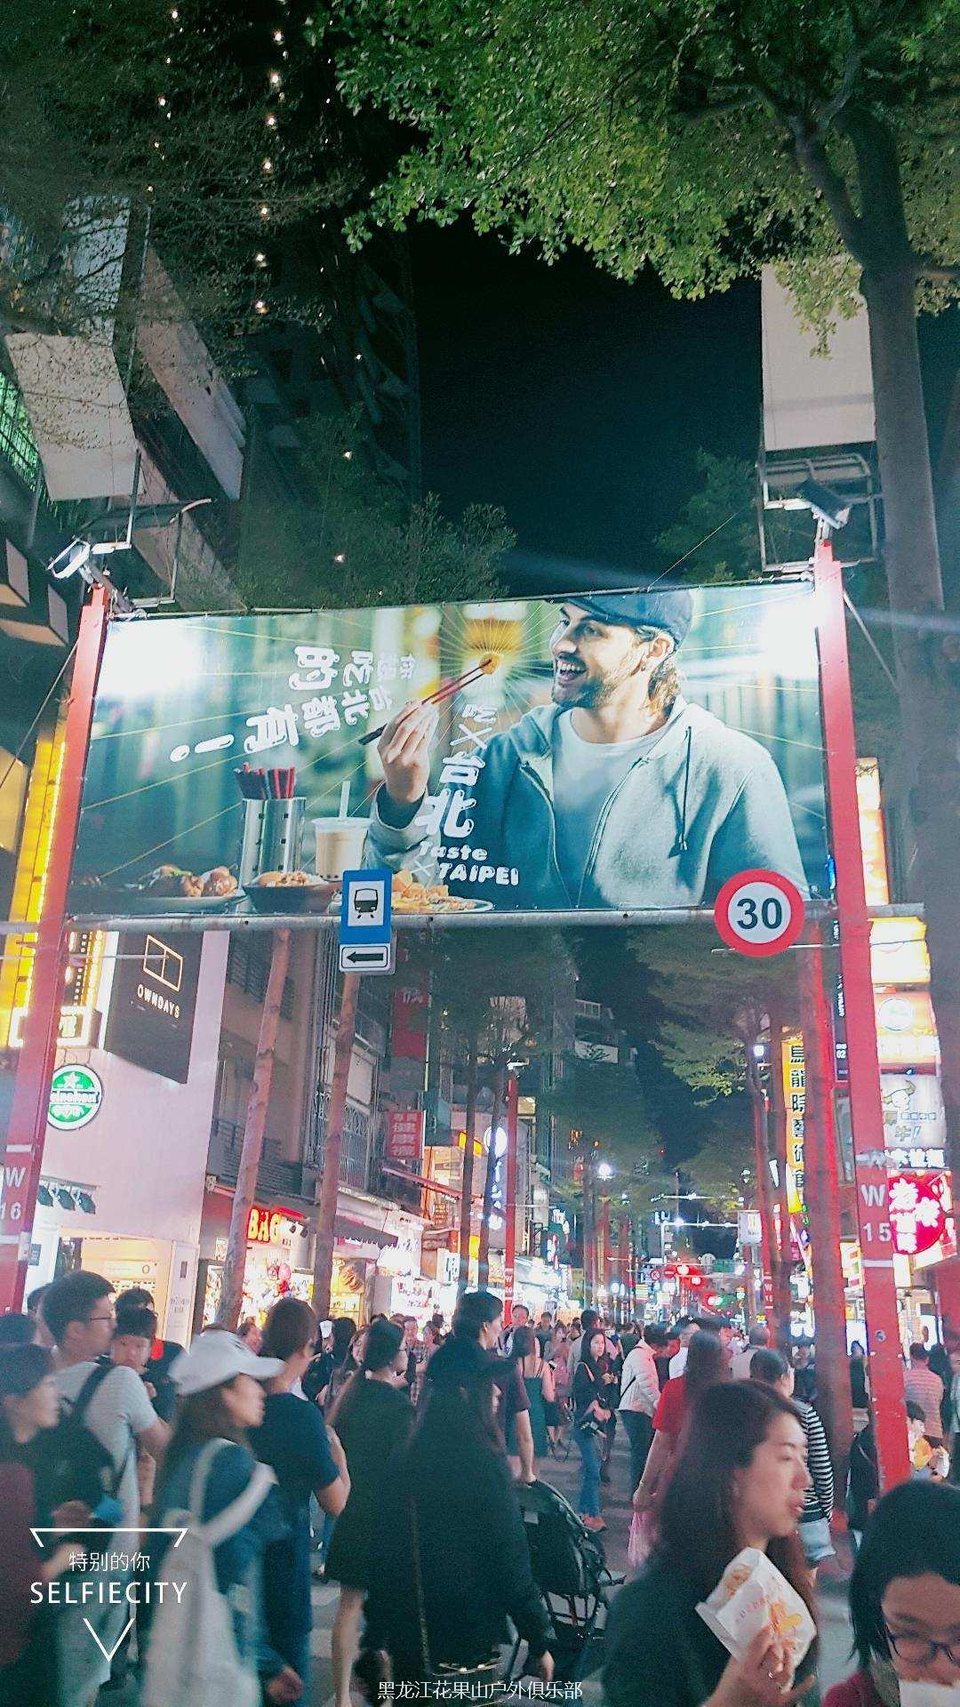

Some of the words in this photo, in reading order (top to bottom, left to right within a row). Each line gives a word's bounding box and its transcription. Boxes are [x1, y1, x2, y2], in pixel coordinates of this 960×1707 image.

[419, 841, 489, 861] Taste
[438, 862, 519, 886] TAIPEI
[736, 897, 783, 930] 30
[136, 983, 182, 1019] OWNDAYS
[5, 1166, 26, 1188] W
[861, 1184, 886, 1207] W
[247, 1208, 282, 1244] BAG
[863, 1223, 892, 1242] 15
